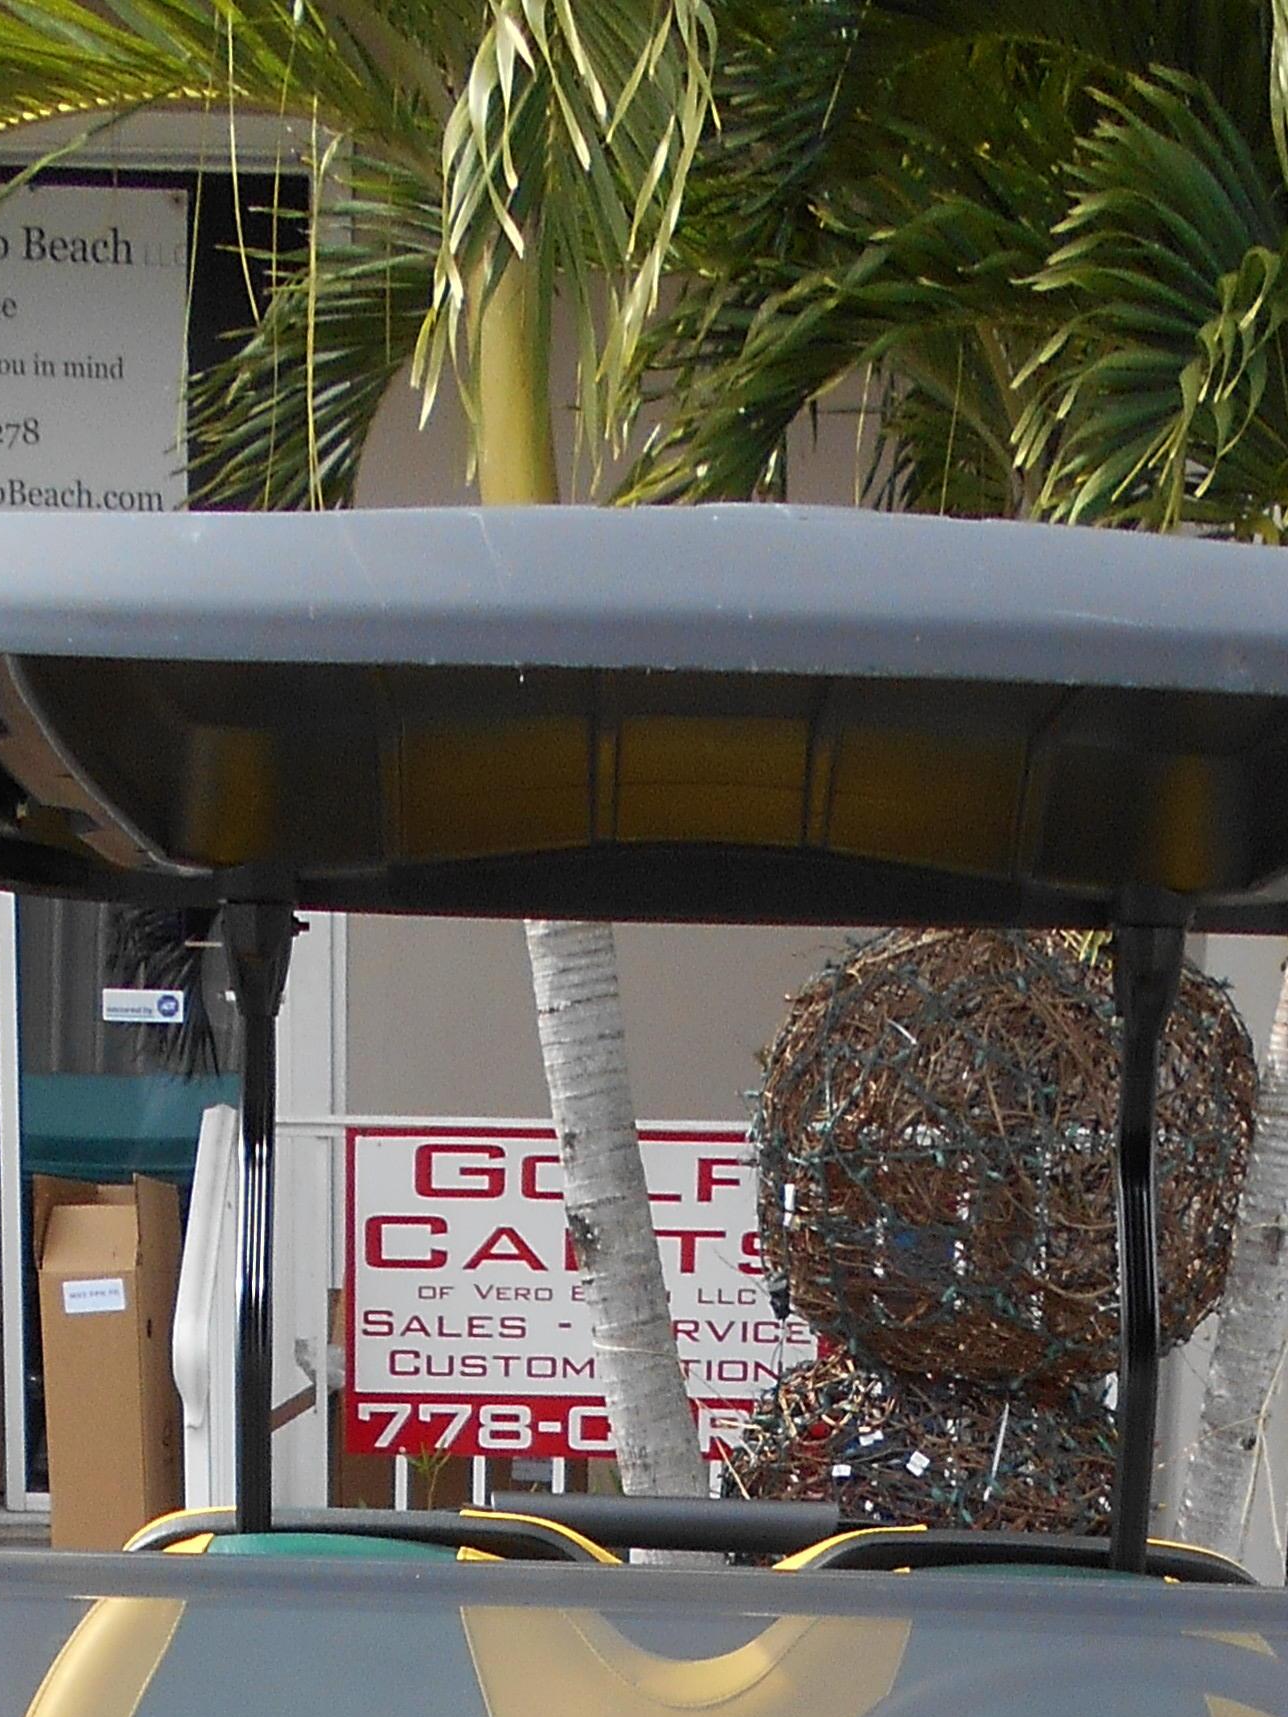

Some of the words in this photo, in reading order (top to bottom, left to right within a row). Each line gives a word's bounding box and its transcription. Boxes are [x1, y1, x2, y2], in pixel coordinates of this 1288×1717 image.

[22, 226, 133, 265] Beach
[33, 352, 56, 377] in
[63, 355, 124, 380] mind
[415, 1143, 744, 1203] GOF
[364, 1215, 766, 1275] CAT
[418, 1285, 455, 1300] OF
[473, 1283, 553, 1302] VERO
[697, 1287, 757, 1306] LLC
[362, 1310, 527, 1339] SALES
[672, 1319, 812, 1345] RVICE
[389, 1349, 783, 1383] CUSTOMTION
[358, 1402, 753, 1453] 778-CR
